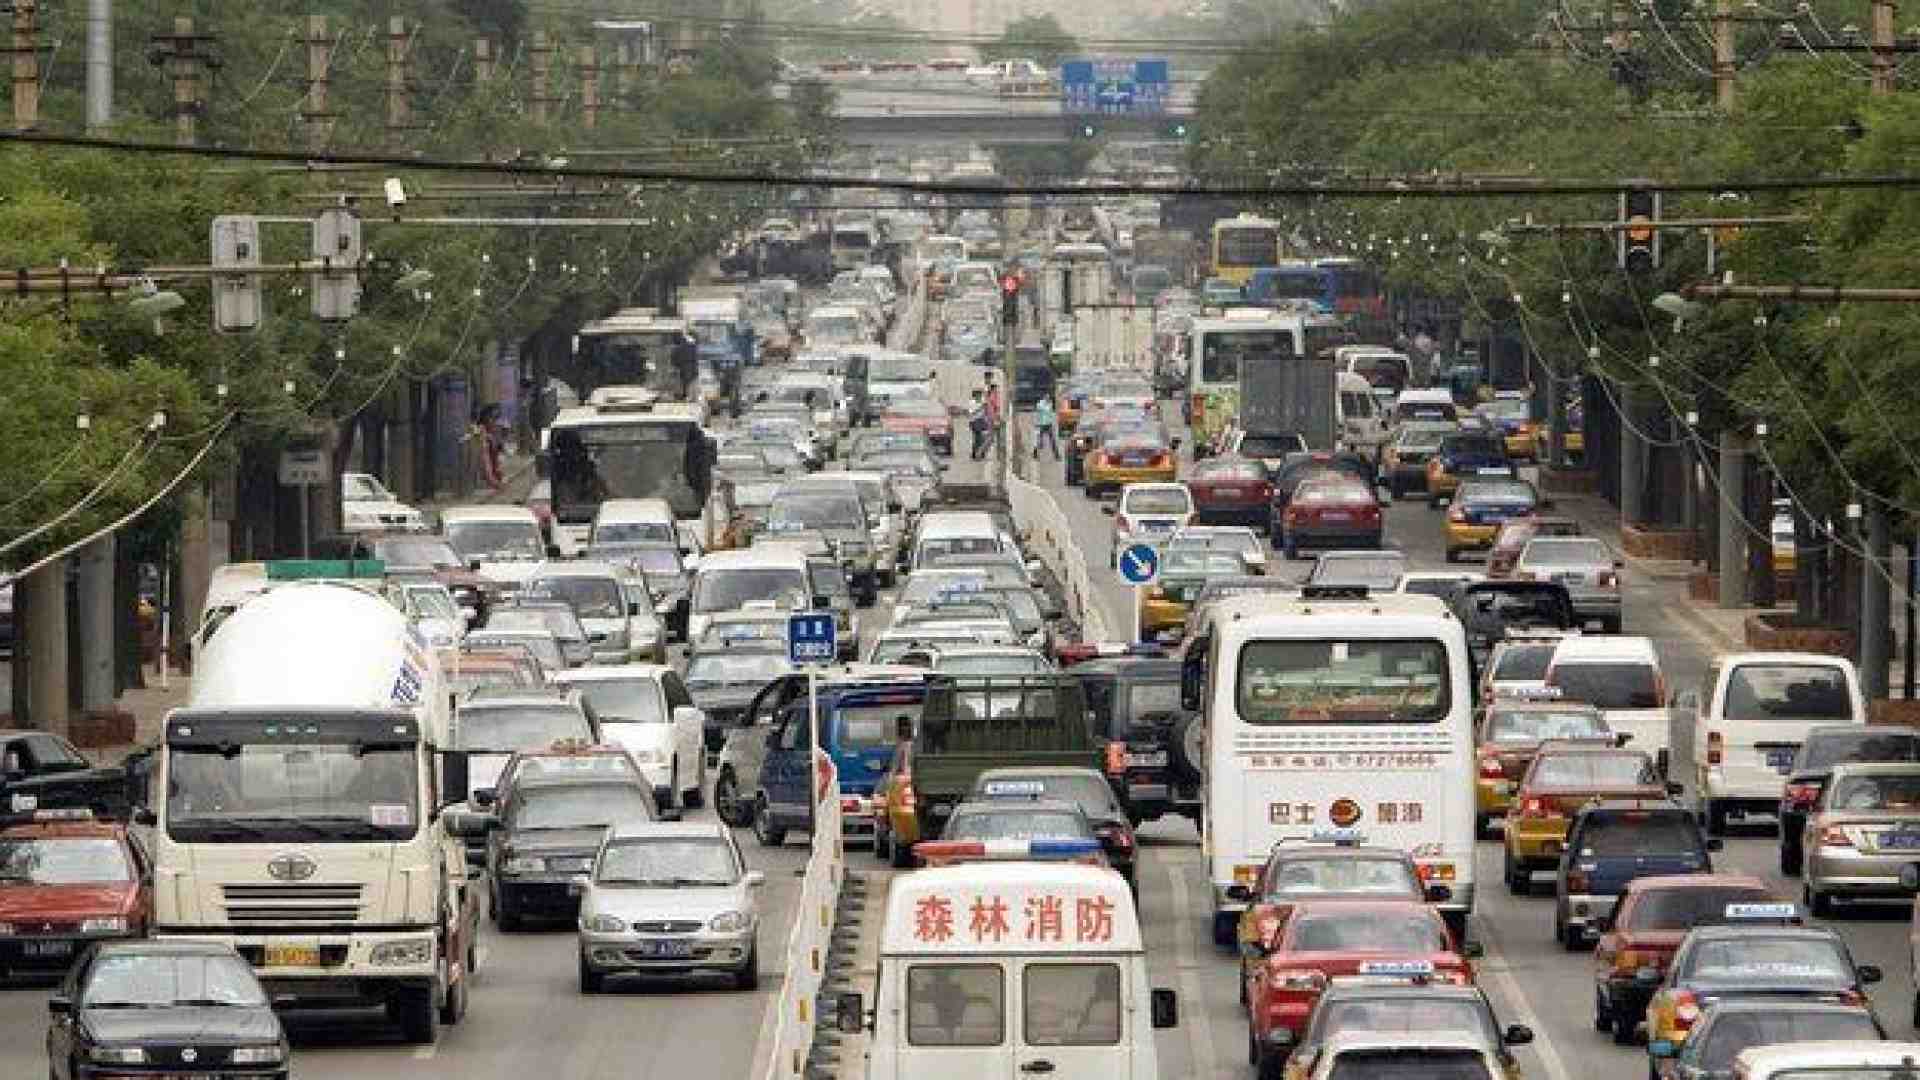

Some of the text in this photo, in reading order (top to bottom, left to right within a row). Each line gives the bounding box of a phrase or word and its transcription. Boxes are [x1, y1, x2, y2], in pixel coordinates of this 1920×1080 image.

[1270, 802, 1315, 824] 巴士
[913, 894, 1114, 943] 森林消防
